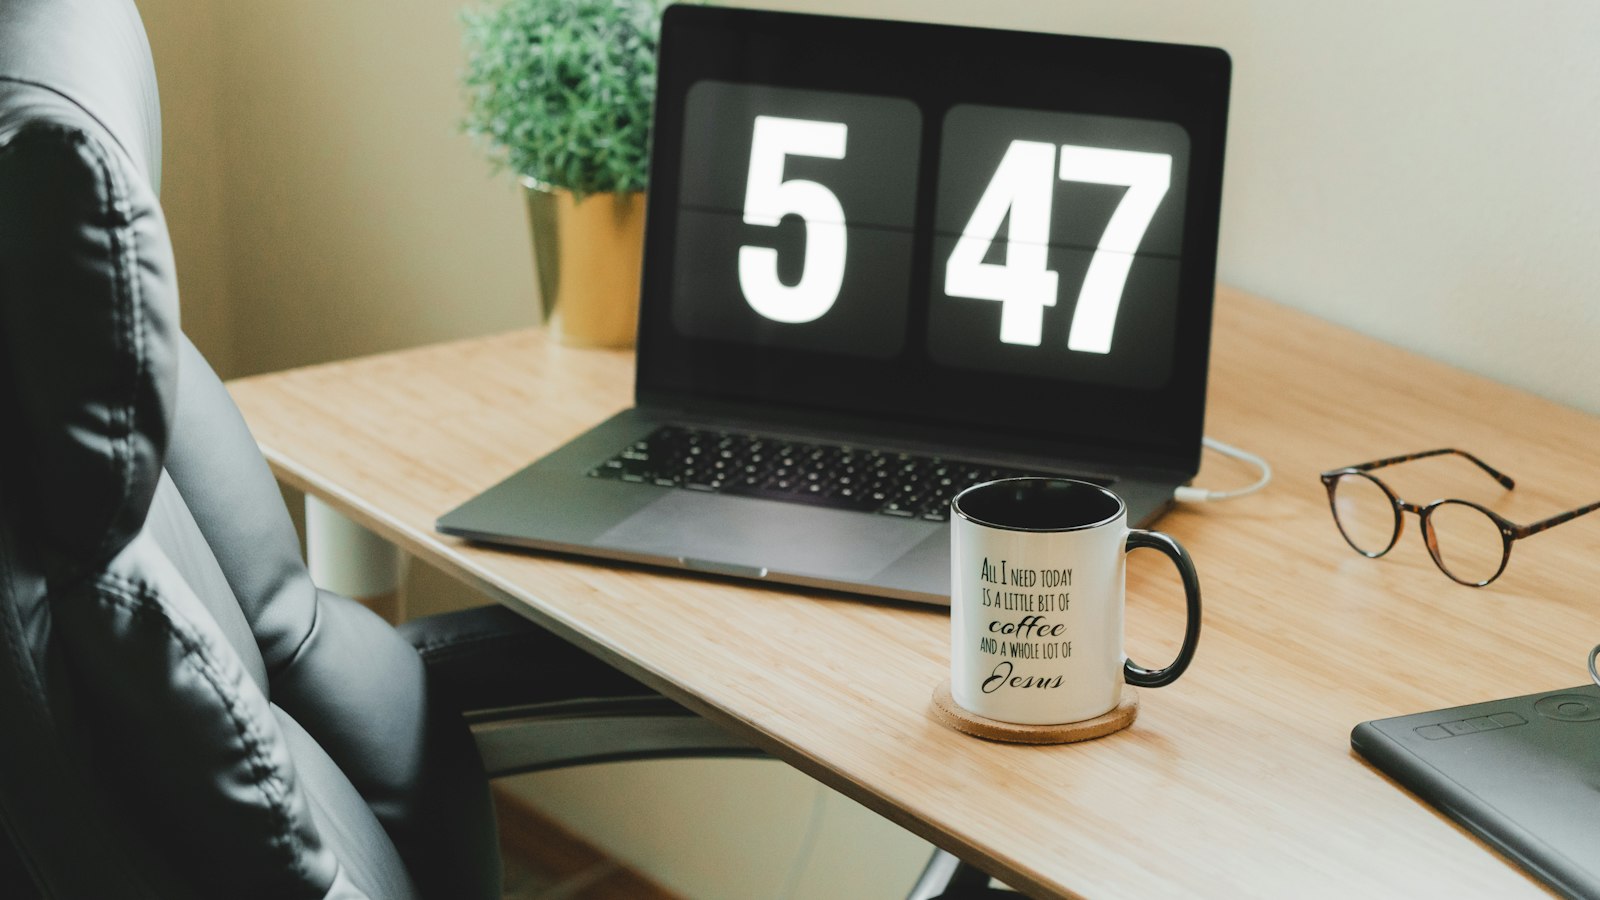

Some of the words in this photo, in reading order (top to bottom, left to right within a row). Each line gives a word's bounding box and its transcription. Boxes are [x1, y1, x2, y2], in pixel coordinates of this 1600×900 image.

[738, 115, 848, 323] 5
[944, 139, 1173, 354] 47
[1001, 560, 1007, 585] I
[1011, 568, 1036, 587] NEED
[1040, 568, 1072, 587] TODAY
[982, 588, 991, 607] IS
[995, 592, 1000, 608] A
[1004, 592, 1034, 612] LITTLE
[1038, 594, 1054, 612] BIT
[1059, 593, 1069, 611] OF
[989, 615, 1067, 639] coffee
[980, 637, 997, 655] AND
[1000, 640, 1006, 656] A
[1010, 642, 1039, 659] WHOLE
[1043, 642, 1058, 659] LOT
[1062, 641, 1072, 658] OF
[981, 661, 1065, 694] Jesus
